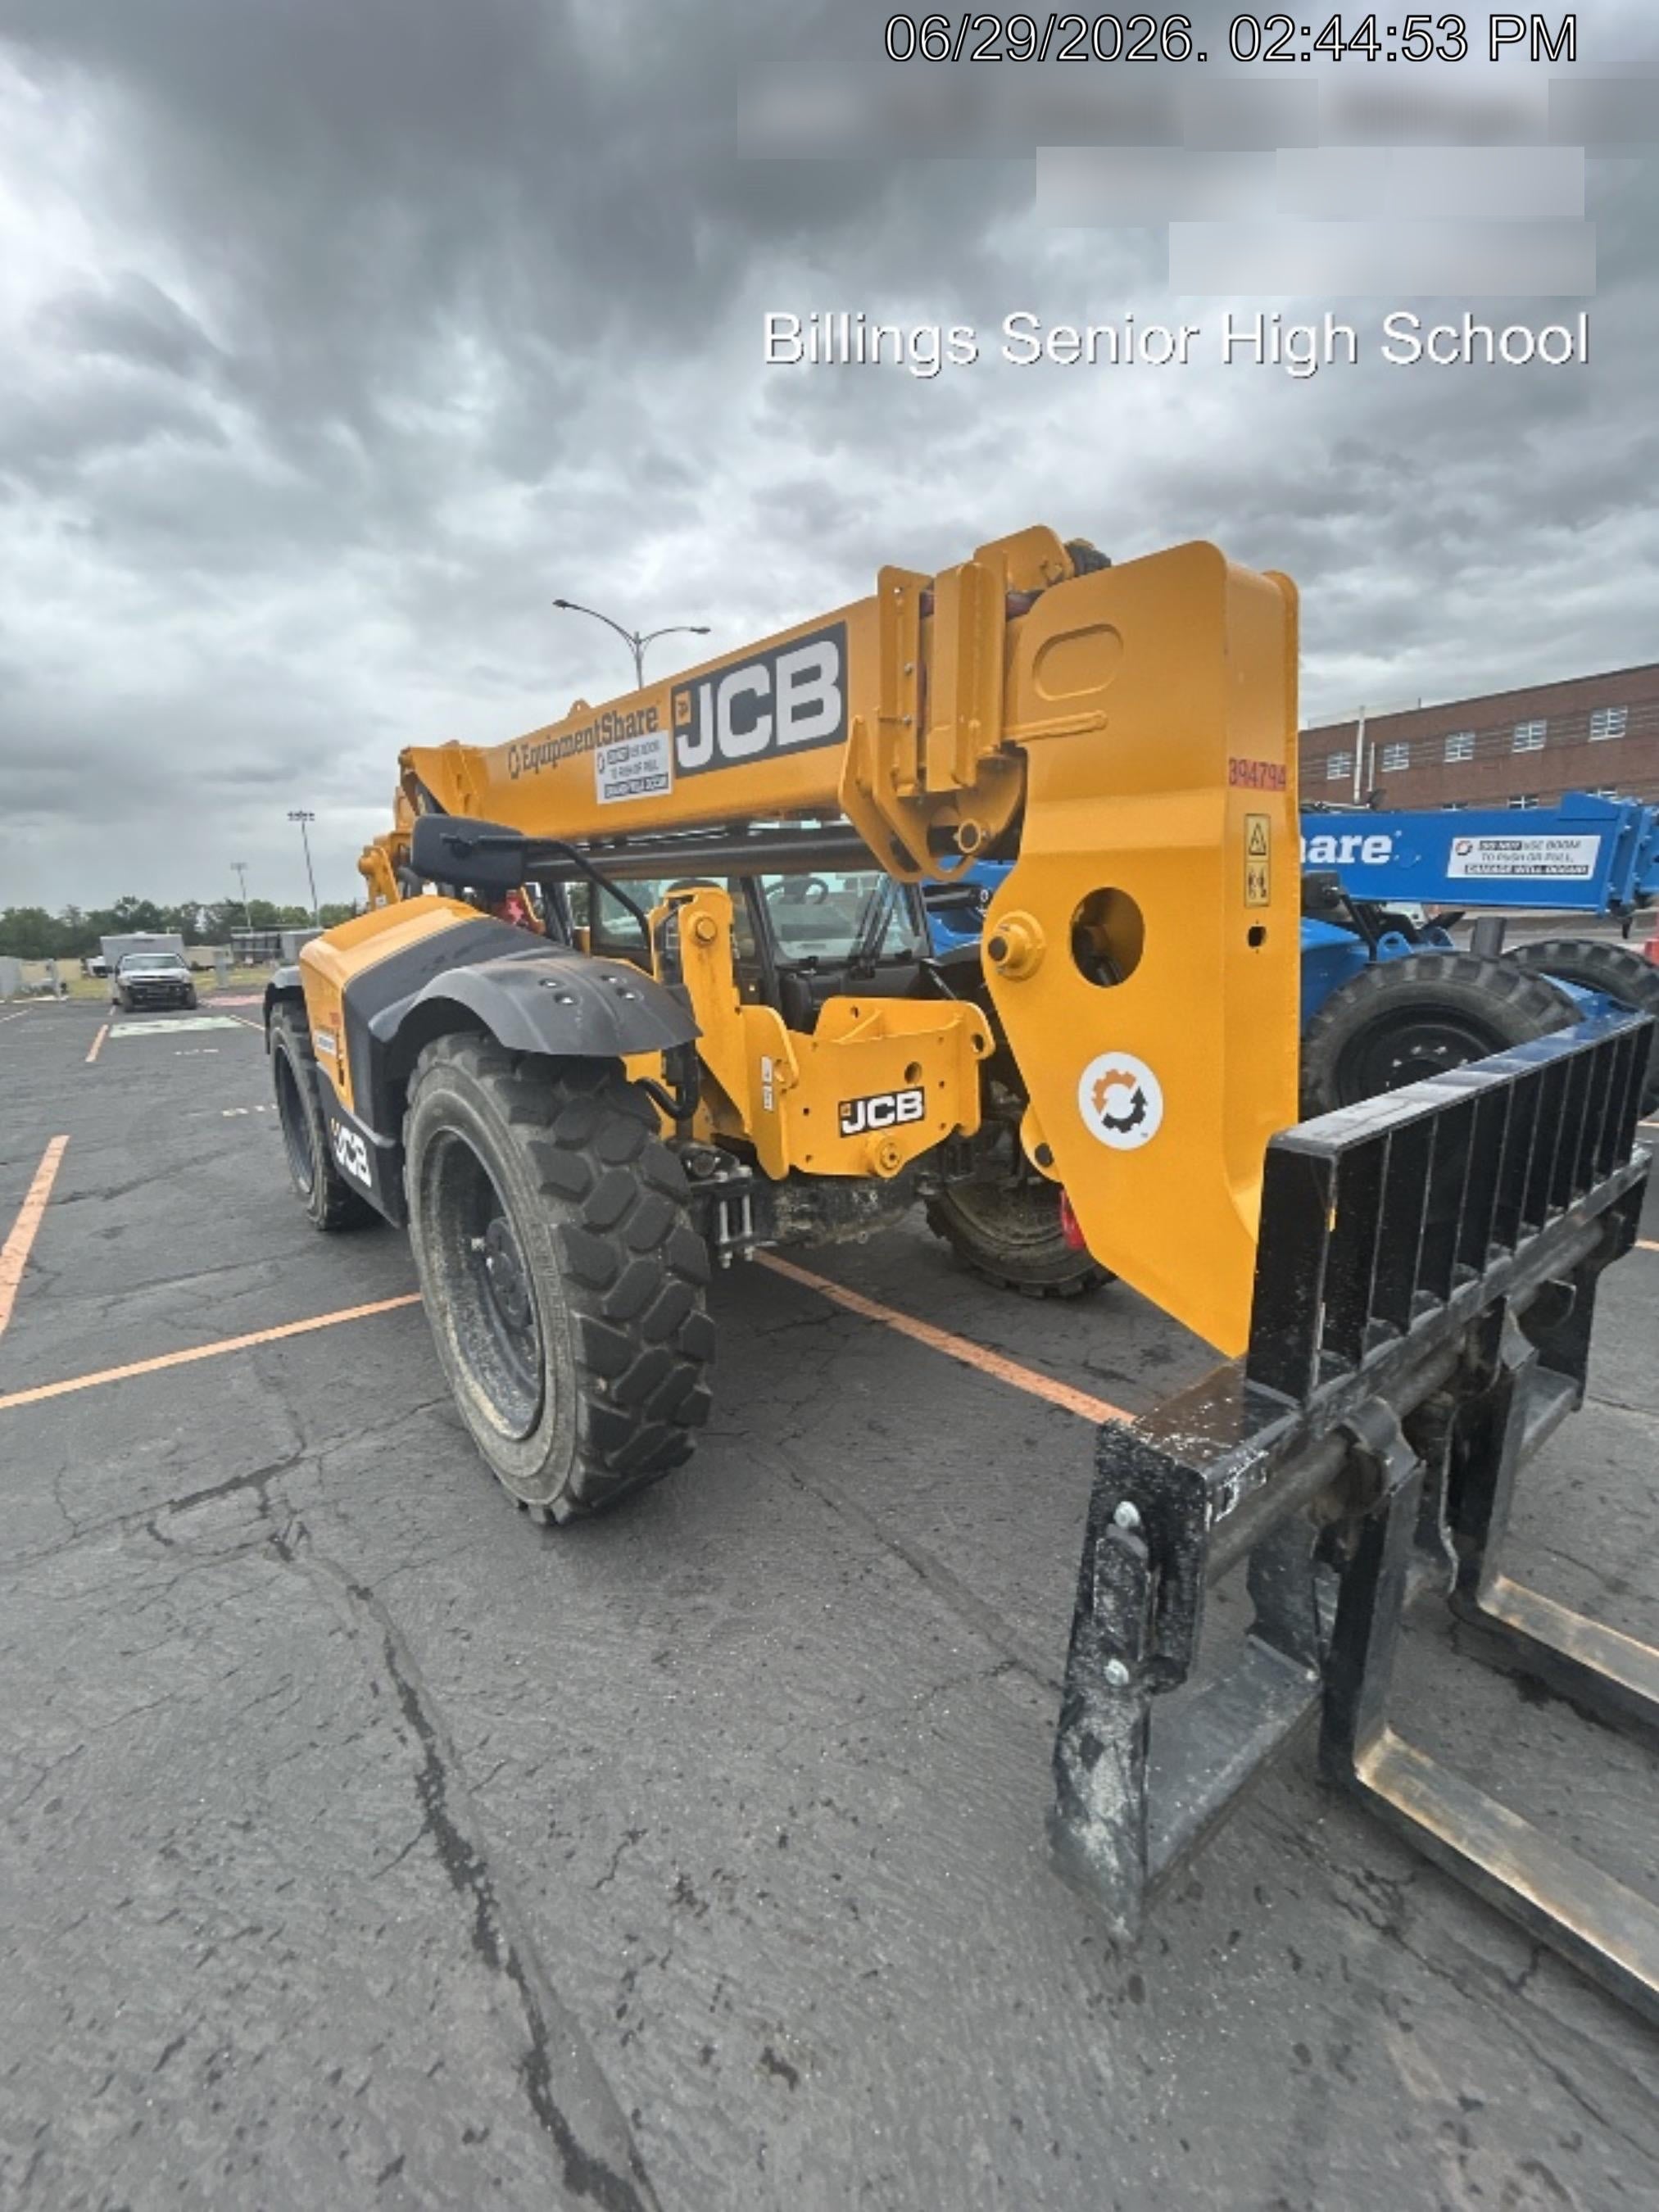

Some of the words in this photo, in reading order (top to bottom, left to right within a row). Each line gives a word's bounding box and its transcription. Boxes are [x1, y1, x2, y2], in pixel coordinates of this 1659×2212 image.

[677, 640, 842, 768] JCB
[523, 707, 660, 774] EquipmentShare
[1230, 758, 1287, 791] 394794
[841, 1090, 923, 1135] JCB
[333, 1126, 372, 1188] JCB
